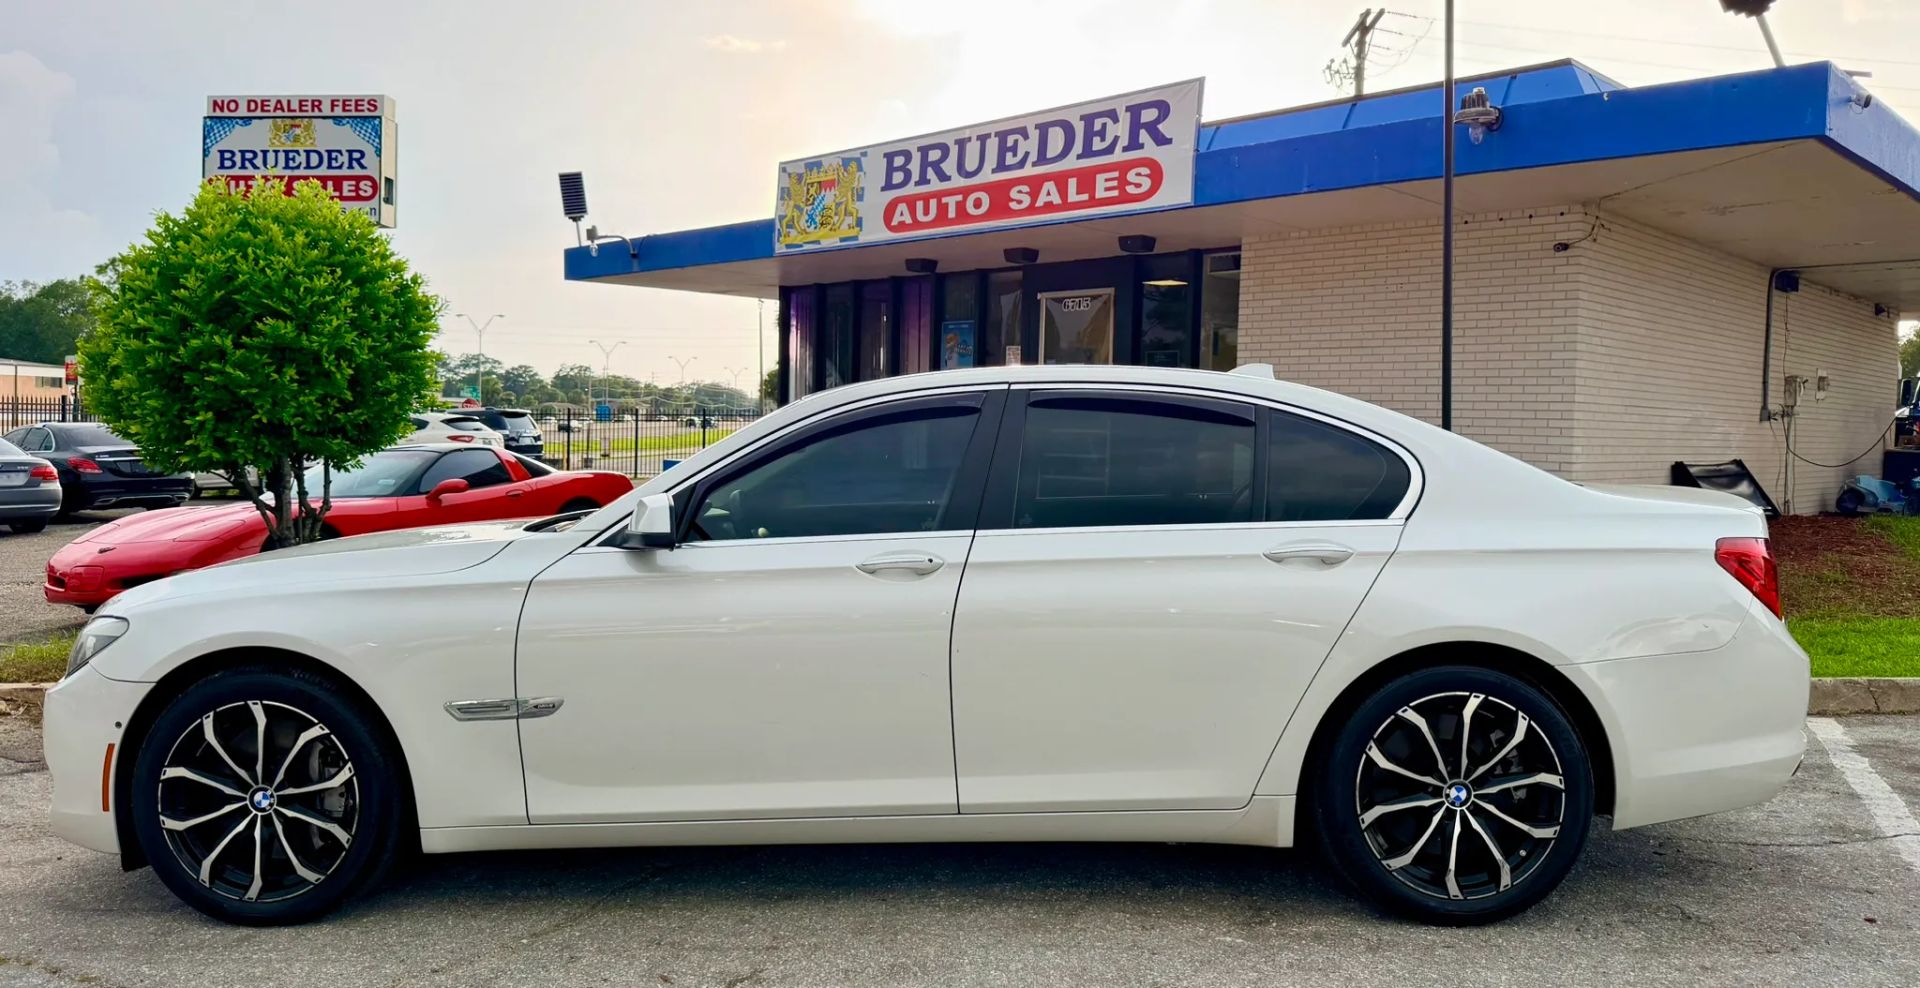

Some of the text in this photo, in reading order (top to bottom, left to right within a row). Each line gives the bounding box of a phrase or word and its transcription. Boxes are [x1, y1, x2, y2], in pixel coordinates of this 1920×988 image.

[212, 99, 379, 113] NO DEALER FEES
[880, 99, 1173, 192] BRUEDER
[217, 149, 368, 170] BRUEDER
[291, 179, 374, 197] SLES
[890, 166, 1152, 226] AUTO SALES
